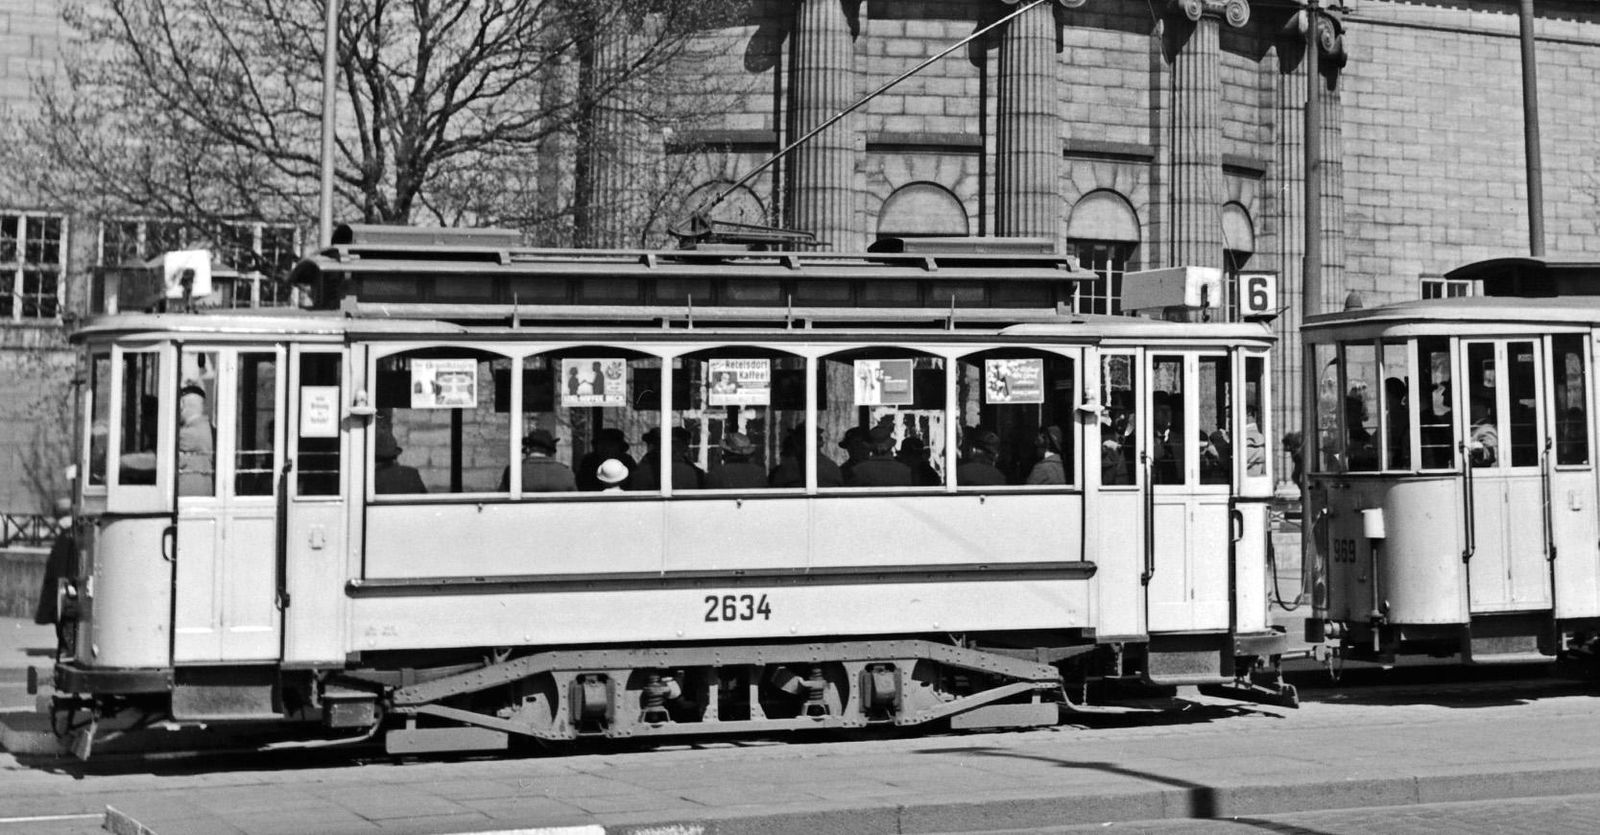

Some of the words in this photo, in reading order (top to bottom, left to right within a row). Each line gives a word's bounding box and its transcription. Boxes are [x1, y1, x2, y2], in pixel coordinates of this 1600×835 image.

[1248, 277, 1268, 311] 6
[1334, 538, 1356, 564] 969
[704, 593, 771, 622] 2634
